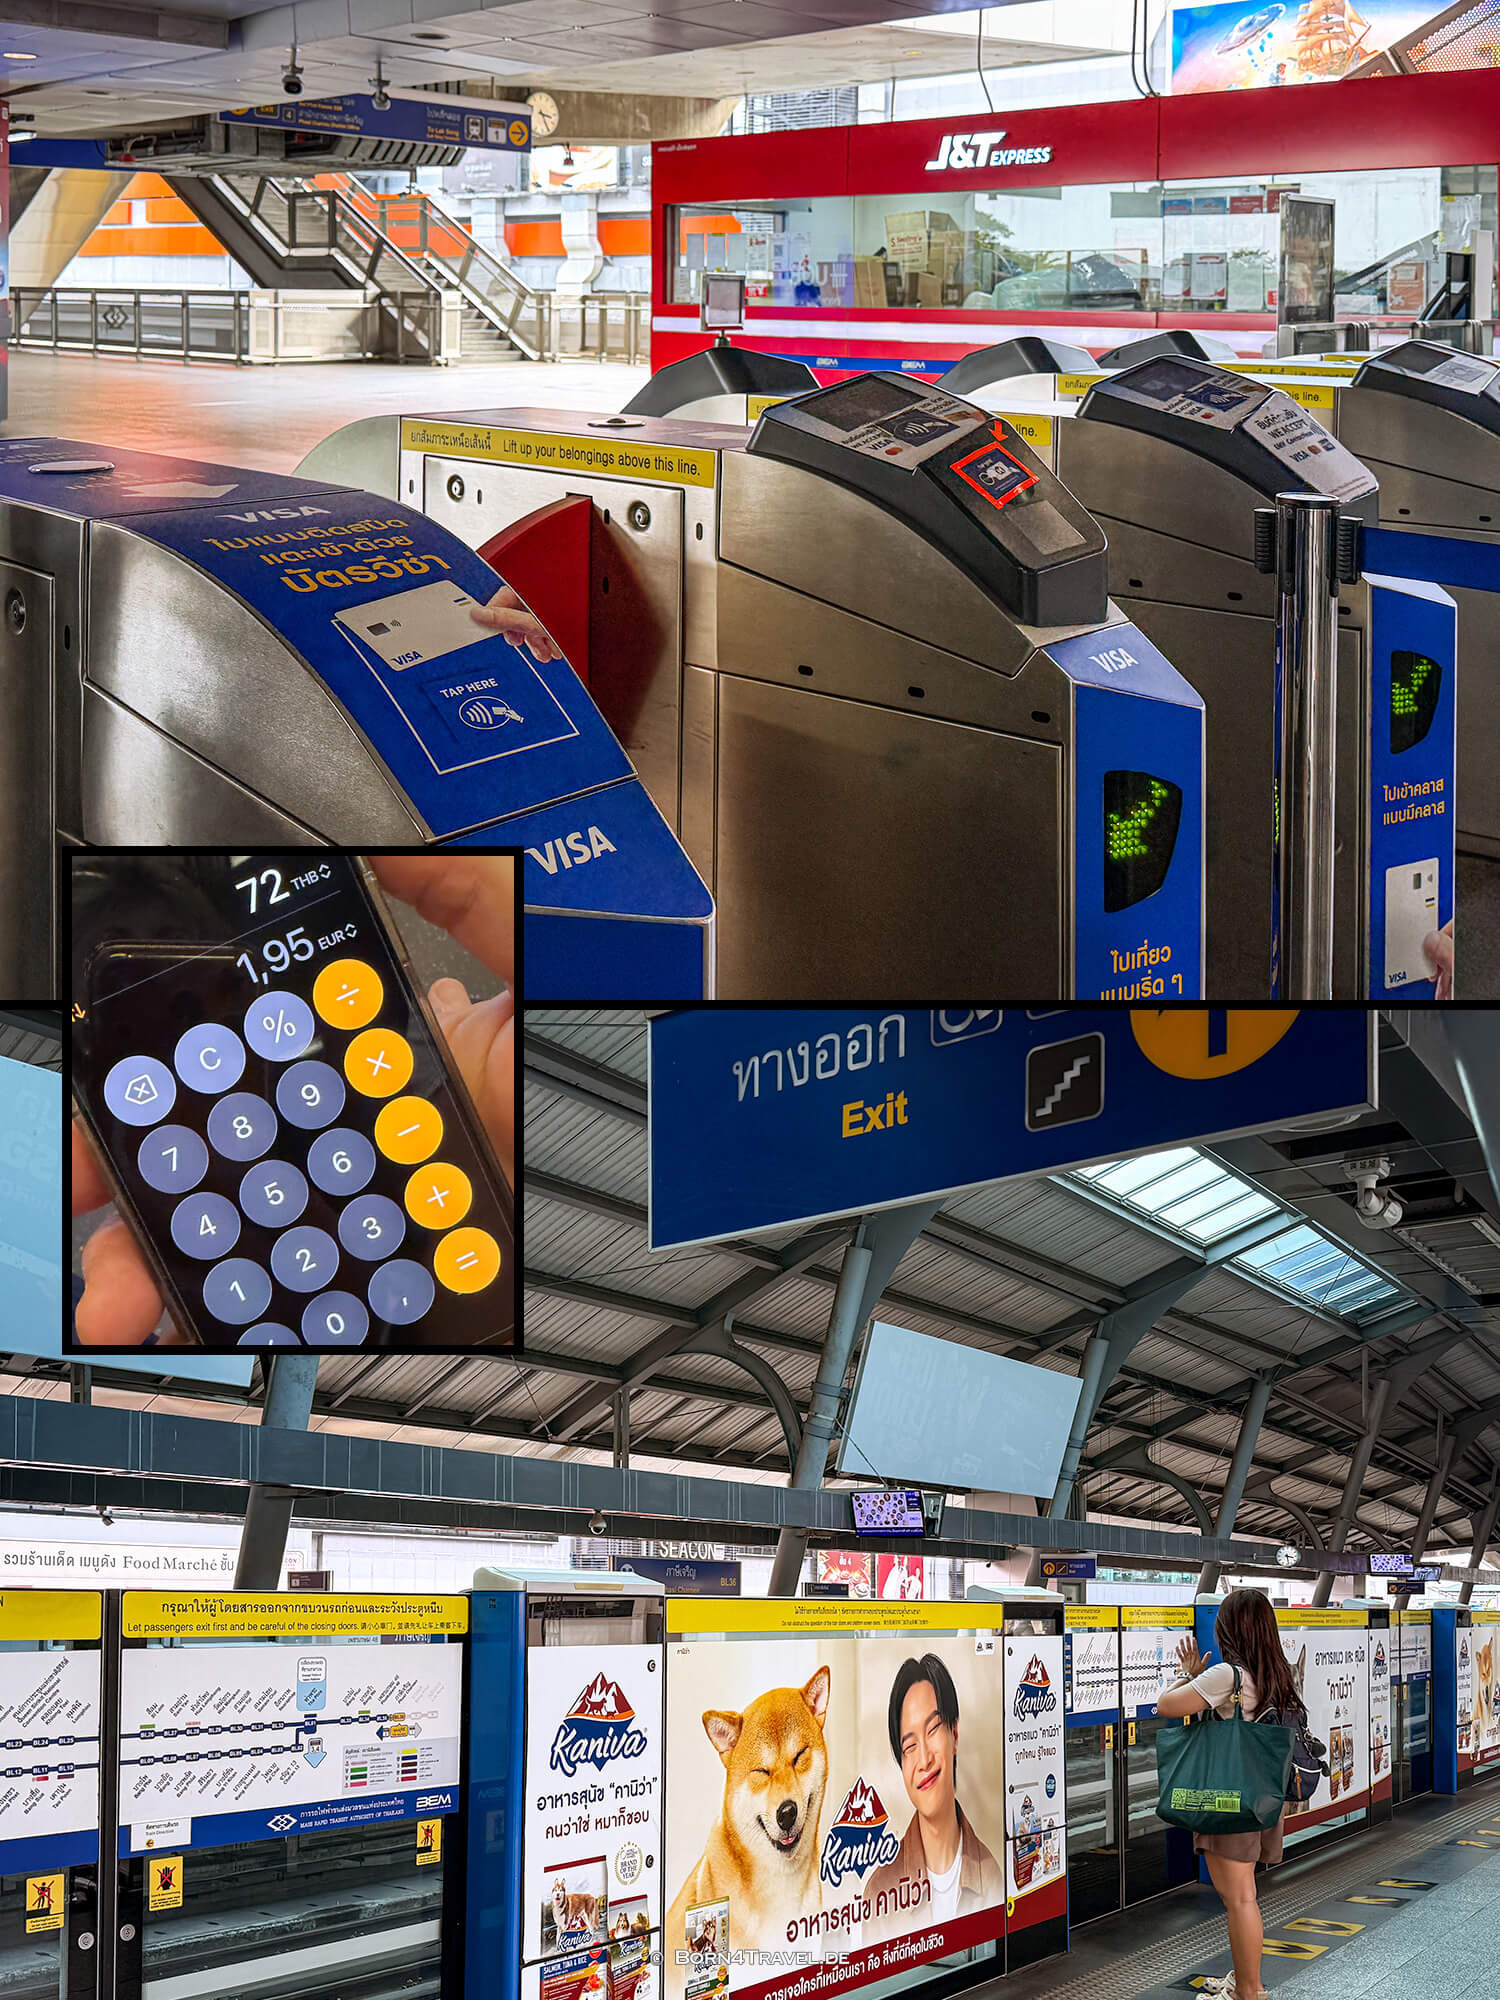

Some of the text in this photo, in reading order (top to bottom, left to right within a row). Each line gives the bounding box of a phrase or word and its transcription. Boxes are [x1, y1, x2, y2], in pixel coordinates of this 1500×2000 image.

[925, 131, 1052, 171] J&T EXPRESS
[867, 438, 895, 451] VISA
[1289, 450, 1311, 462] VISA
[503, 439, 701, 477] Lift up your belongings above this line.
[215, 506, 331, 523] VISA
[280, 551, 451, 593] บัตรวีซ่า
[391, 650, 424, 667] VISA
[1088, 647, 1139, 674] VISA
[440, 677, 499, 699] TAP HERE
[1383, 778, 1444, 803] ไปเข้าคลาส
[1383, 801, 1445, 826] แบบมีคลาส
[524, 825, 617, 875] VISA
[235, 868, 320, 914] 72 THB
[236, 926, 346, 985] 1,95 EUR
[1110, 938, 1172, 975] ไปเที่ยว
[200, 1047, 221, 1071] C
[732, 1012, 906, 1103] ทางออก
[300, 1083, 322, 1108] 9
[842, 1090, 909, 1139] Exit
[231, 1116, 253, 1140] 8
[161, 1147, 180, 1173] 7
[332, 1151, 353, 1174] 6
[264, 1181, 285, 1206] 5
[198, 1214, 218, 1238] 4
[361, 1217, 382, 1240] 3
[295, 1248, 317, 1273] 2
[229, 1279, 248, 1302] 1
[326, 1312, 345, 1335] 0
[4, 1551, 234, 1572] รวมร้านเด็ด เมนูดัง Food Marché ชั้น
[659, 1540, 715, 1560] SEACON
[720, 1577, 736, 1587] BL36
[128, 1622, 360, 1633] Let passengers exit first and be careful of the closing doors.
[1013, 1688, 1057, 1722] Kaniva
[549, 1723, 648, 1778] Kaniva
[416, 1793, 452, 1809] BEM
[537, 1783, 605, 1811] อาหารสุนัข
[545, 1806, 650, 1839] คนว่าใช่ หมาก็ชอบ
[820, 1828, 900, 1887] Kaniva
[786, 1868, 931, 1943] อาหารสุนัข คานิว่า
[557, 1931, 593, 1952] Kaniva
[867, 1953, 881, 1972] คือ
